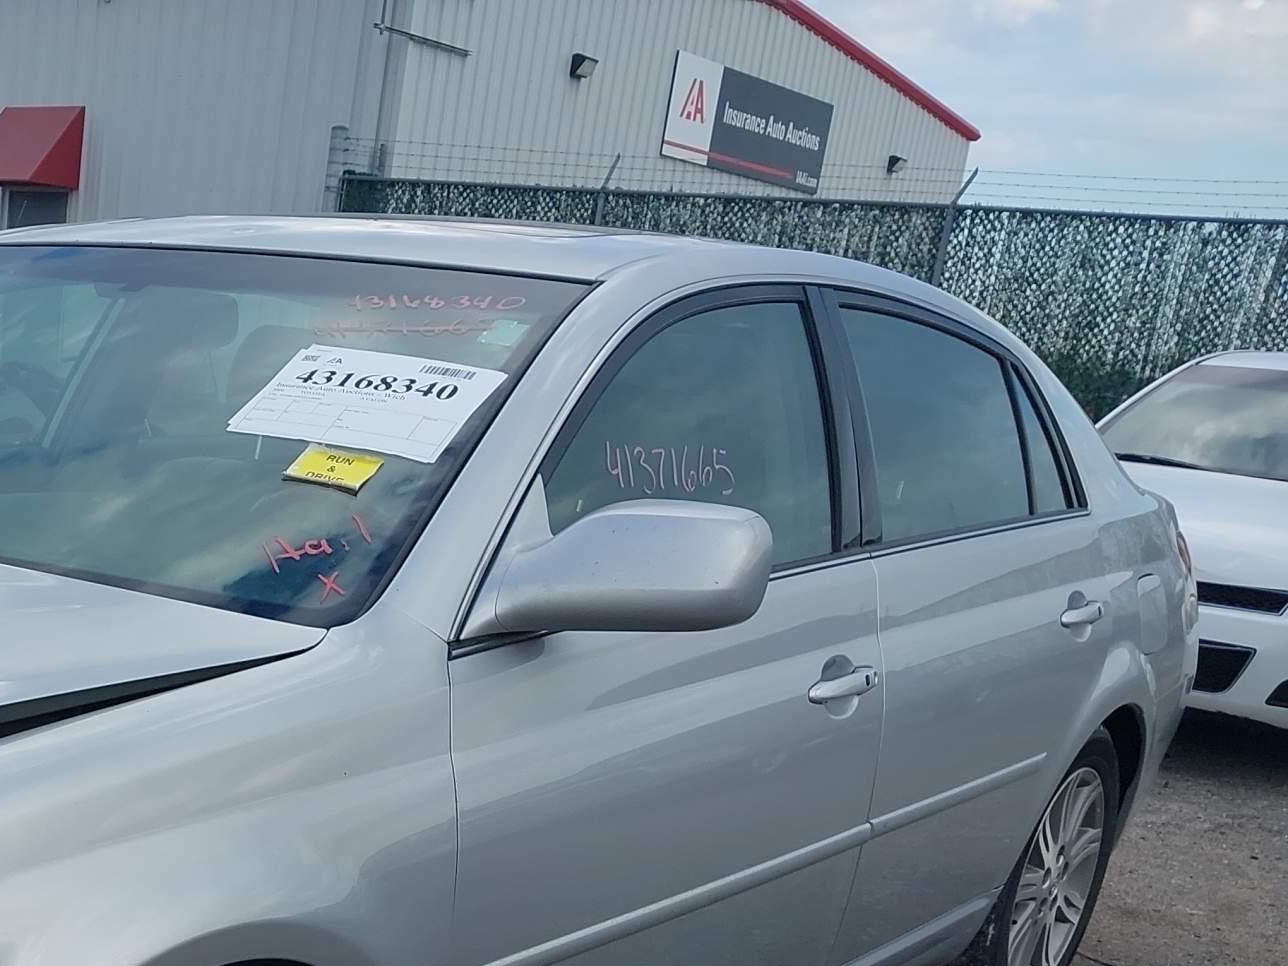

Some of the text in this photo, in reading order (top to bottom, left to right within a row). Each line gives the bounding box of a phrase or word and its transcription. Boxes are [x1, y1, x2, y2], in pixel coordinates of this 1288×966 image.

[723, 101, 821, 151] Insurance Auto Auctions
[296, 369, 459, 400] 43168340
[326, 454, 355, 466] RUN
[326, 465, 336, 473] &
[605, 440, 736, 495] 41371665
